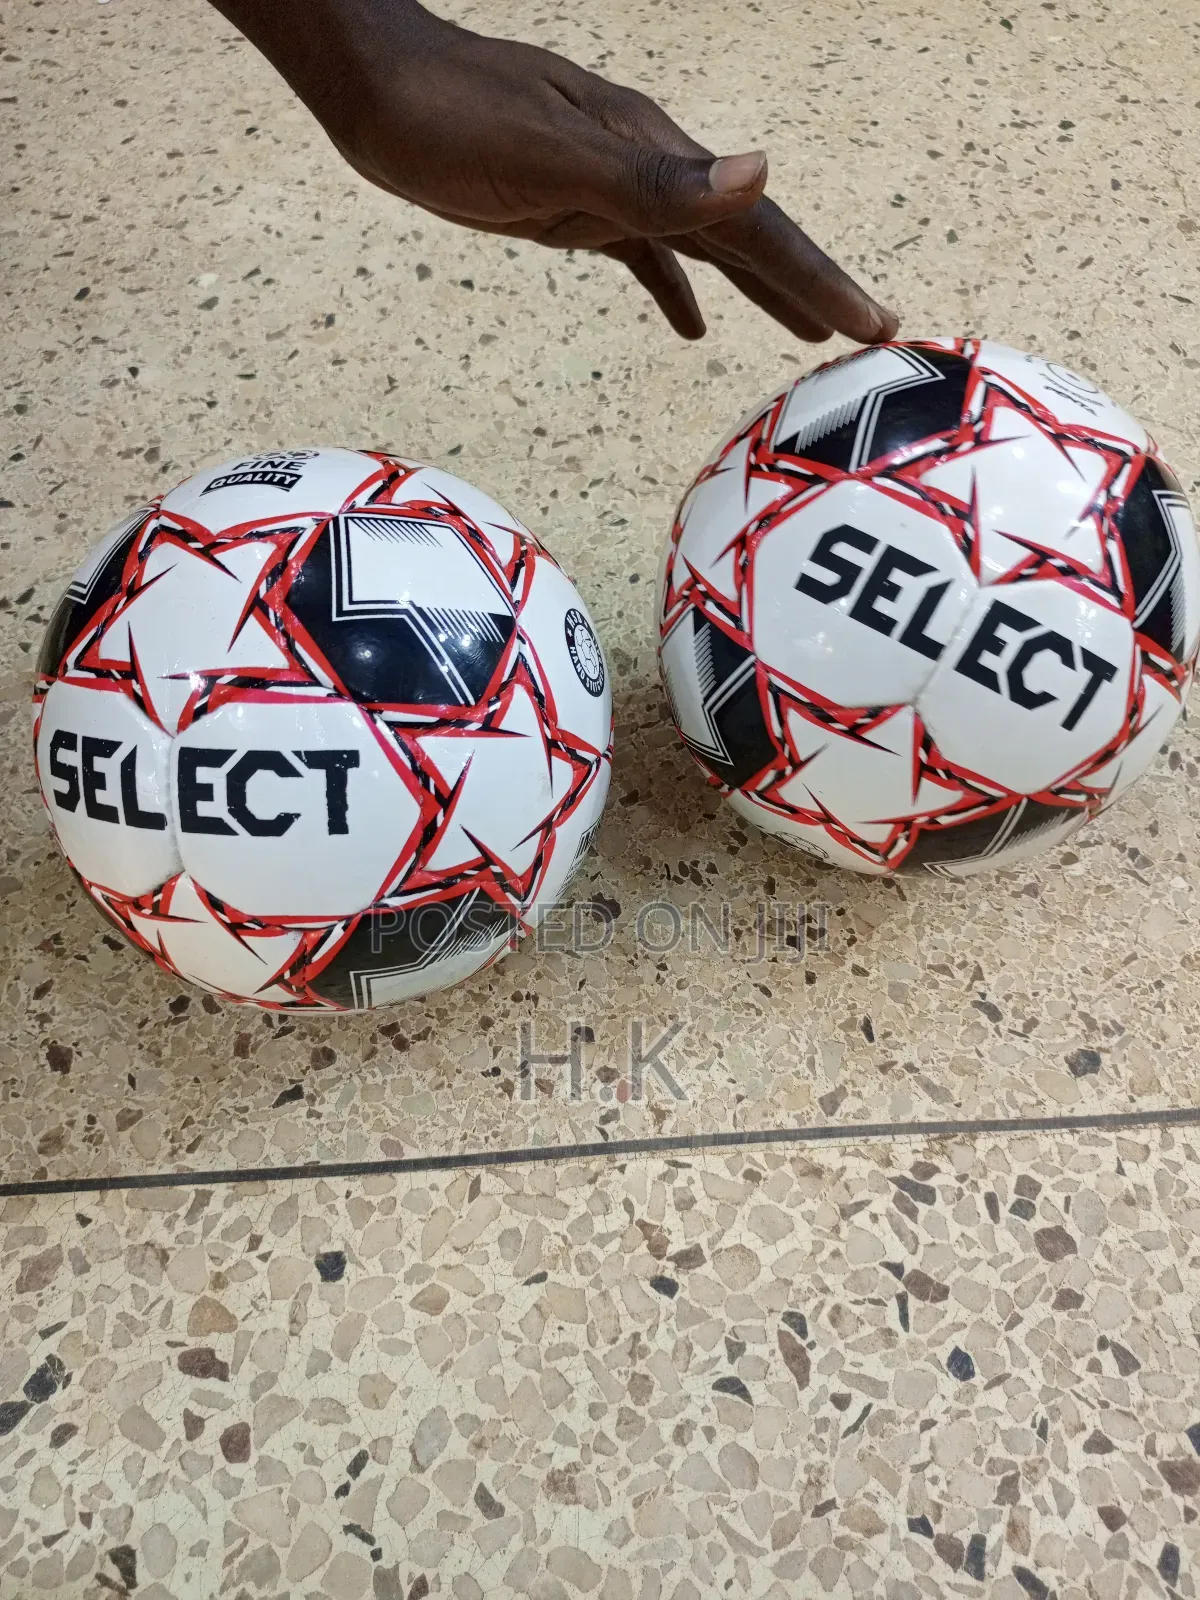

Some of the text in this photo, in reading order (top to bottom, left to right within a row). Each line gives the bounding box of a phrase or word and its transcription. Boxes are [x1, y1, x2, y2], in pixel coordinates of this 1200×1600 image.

[210, 472, 298, 489] QUALITY
[231, 460, 306, 471] FINE
[793, 523, 1119, 732] SELECT
[50, 729, 360, 837] SELECT
